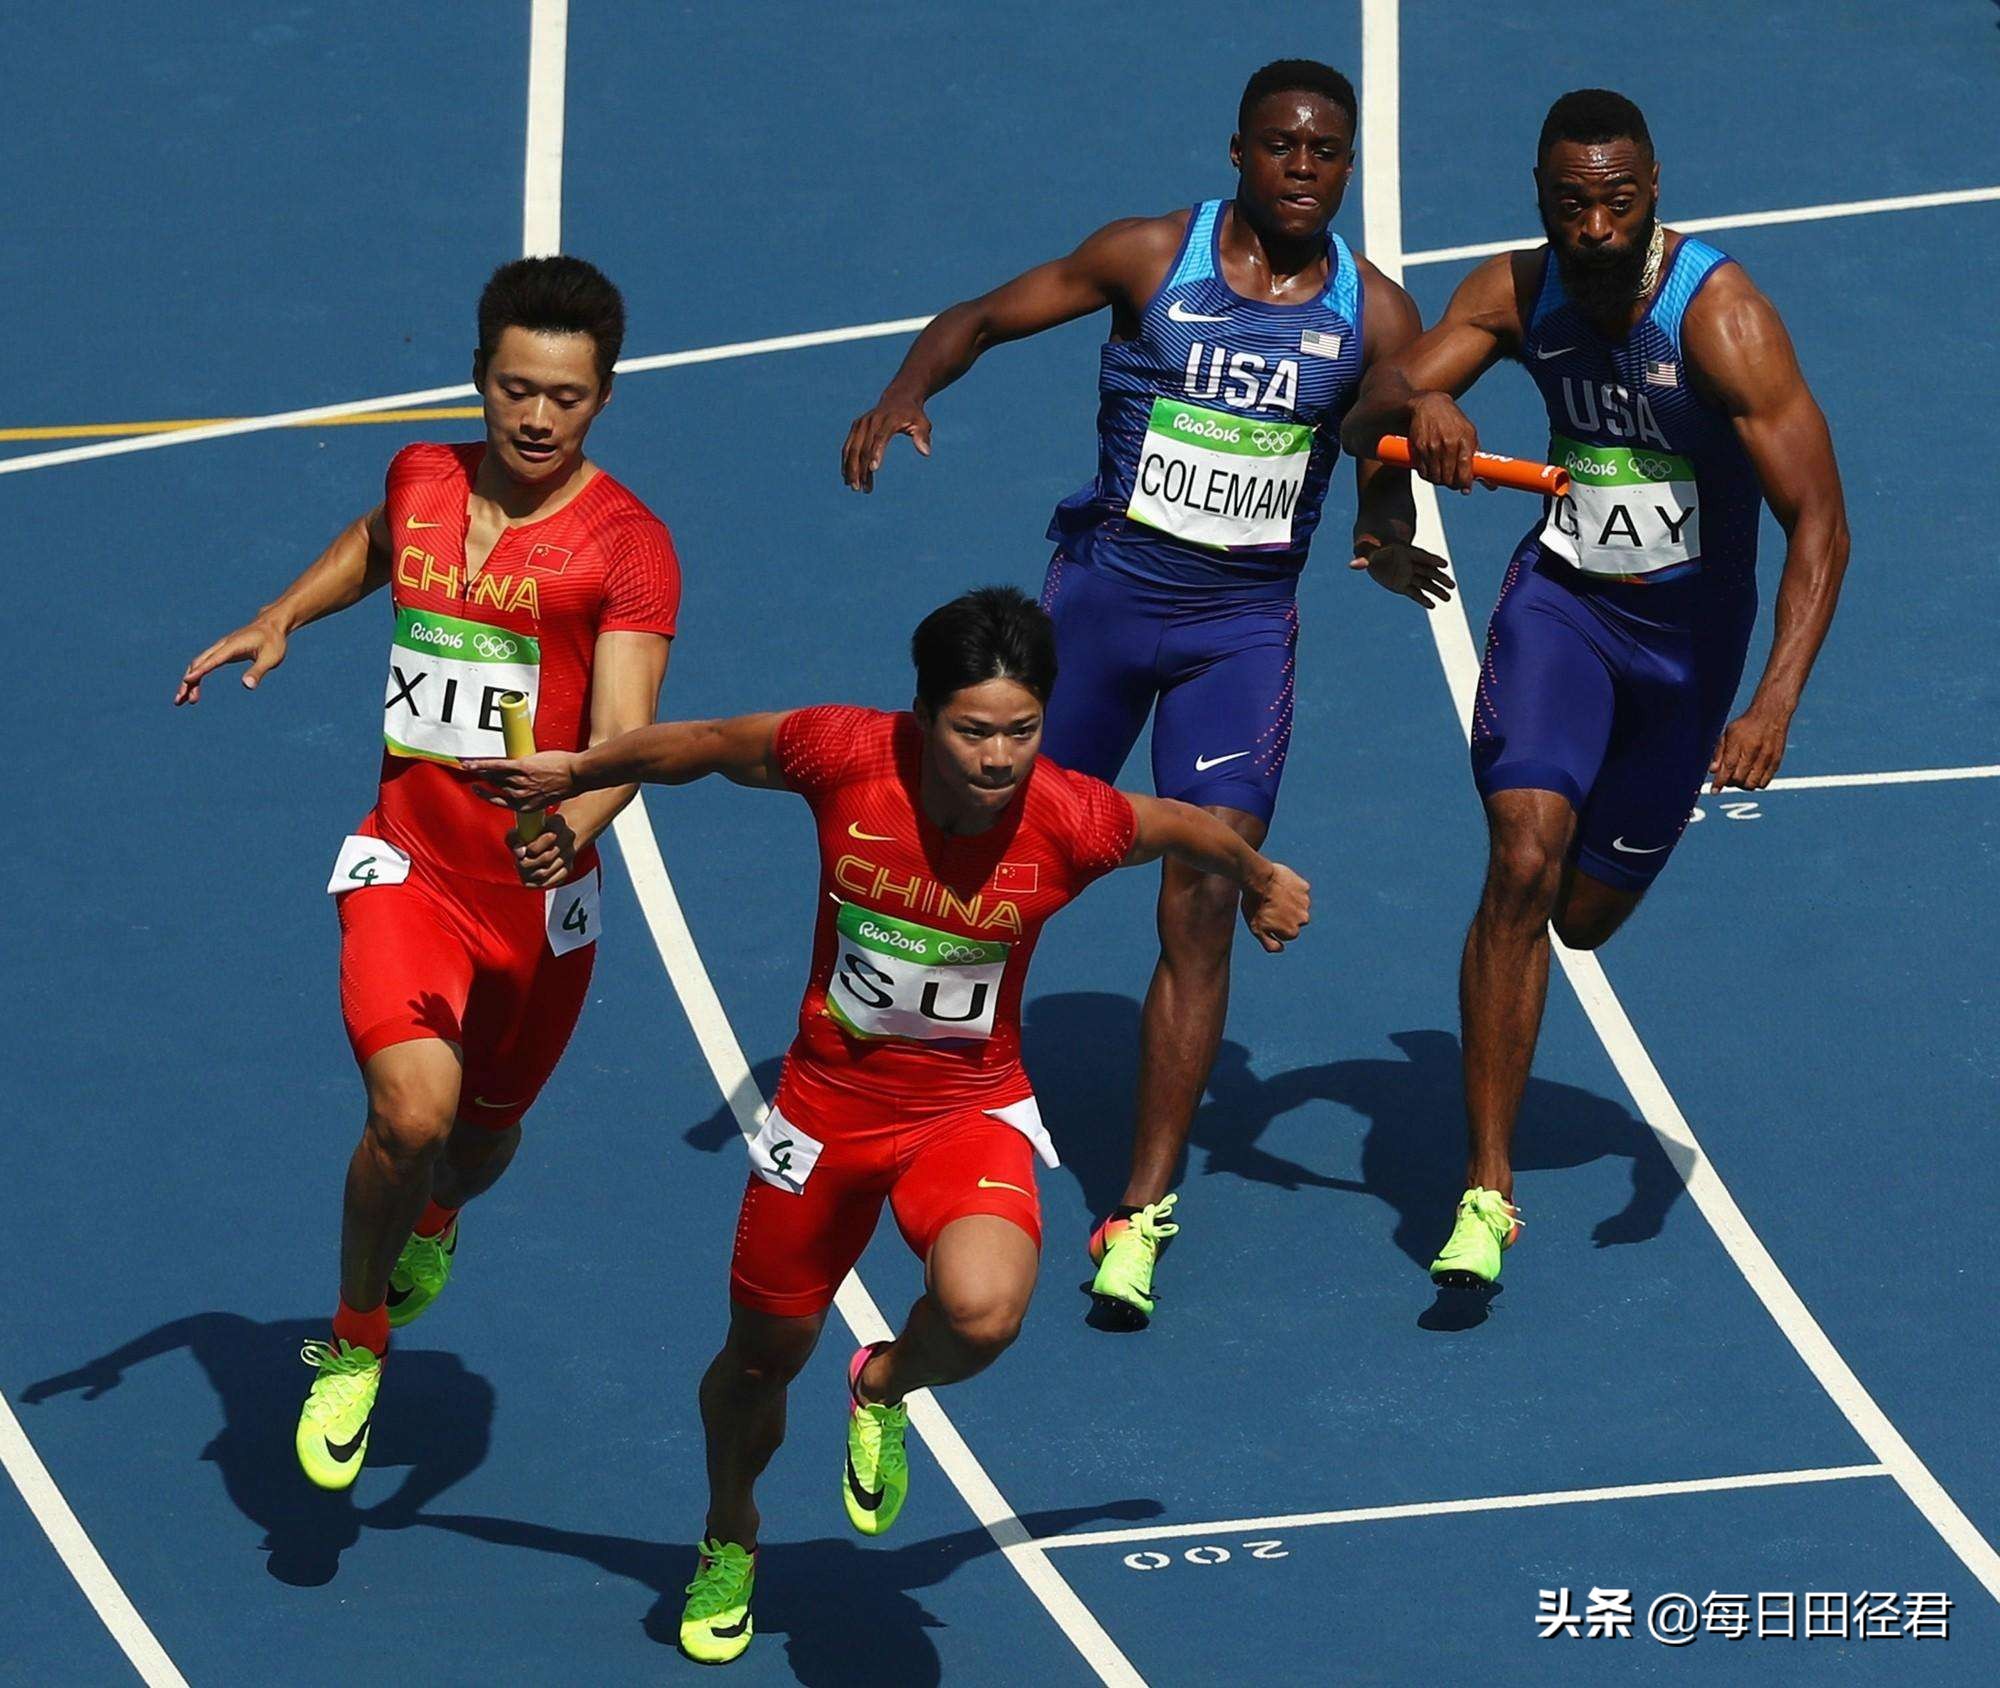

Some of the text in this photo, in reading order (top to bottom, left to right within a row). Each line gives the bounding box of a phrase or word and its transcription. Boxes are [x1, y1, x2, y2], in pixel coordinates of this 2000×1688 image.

[1183, 342, 1299, 413] USA
[1562, 377, 1672, 450] USA
[1141, 453, 1298, 520] COLEMAN
[1554, 493, 1696, 547] GAY
[397, 544, 541, 620] CHINA
[562, 897, 588, 935] 4
[835, 854, 1023, 935] CHINA
[839, 953, 990, 1022] SU
[770, 1140, 794, 1175] 4
[1124, 1541, 1289, 1570] 200
